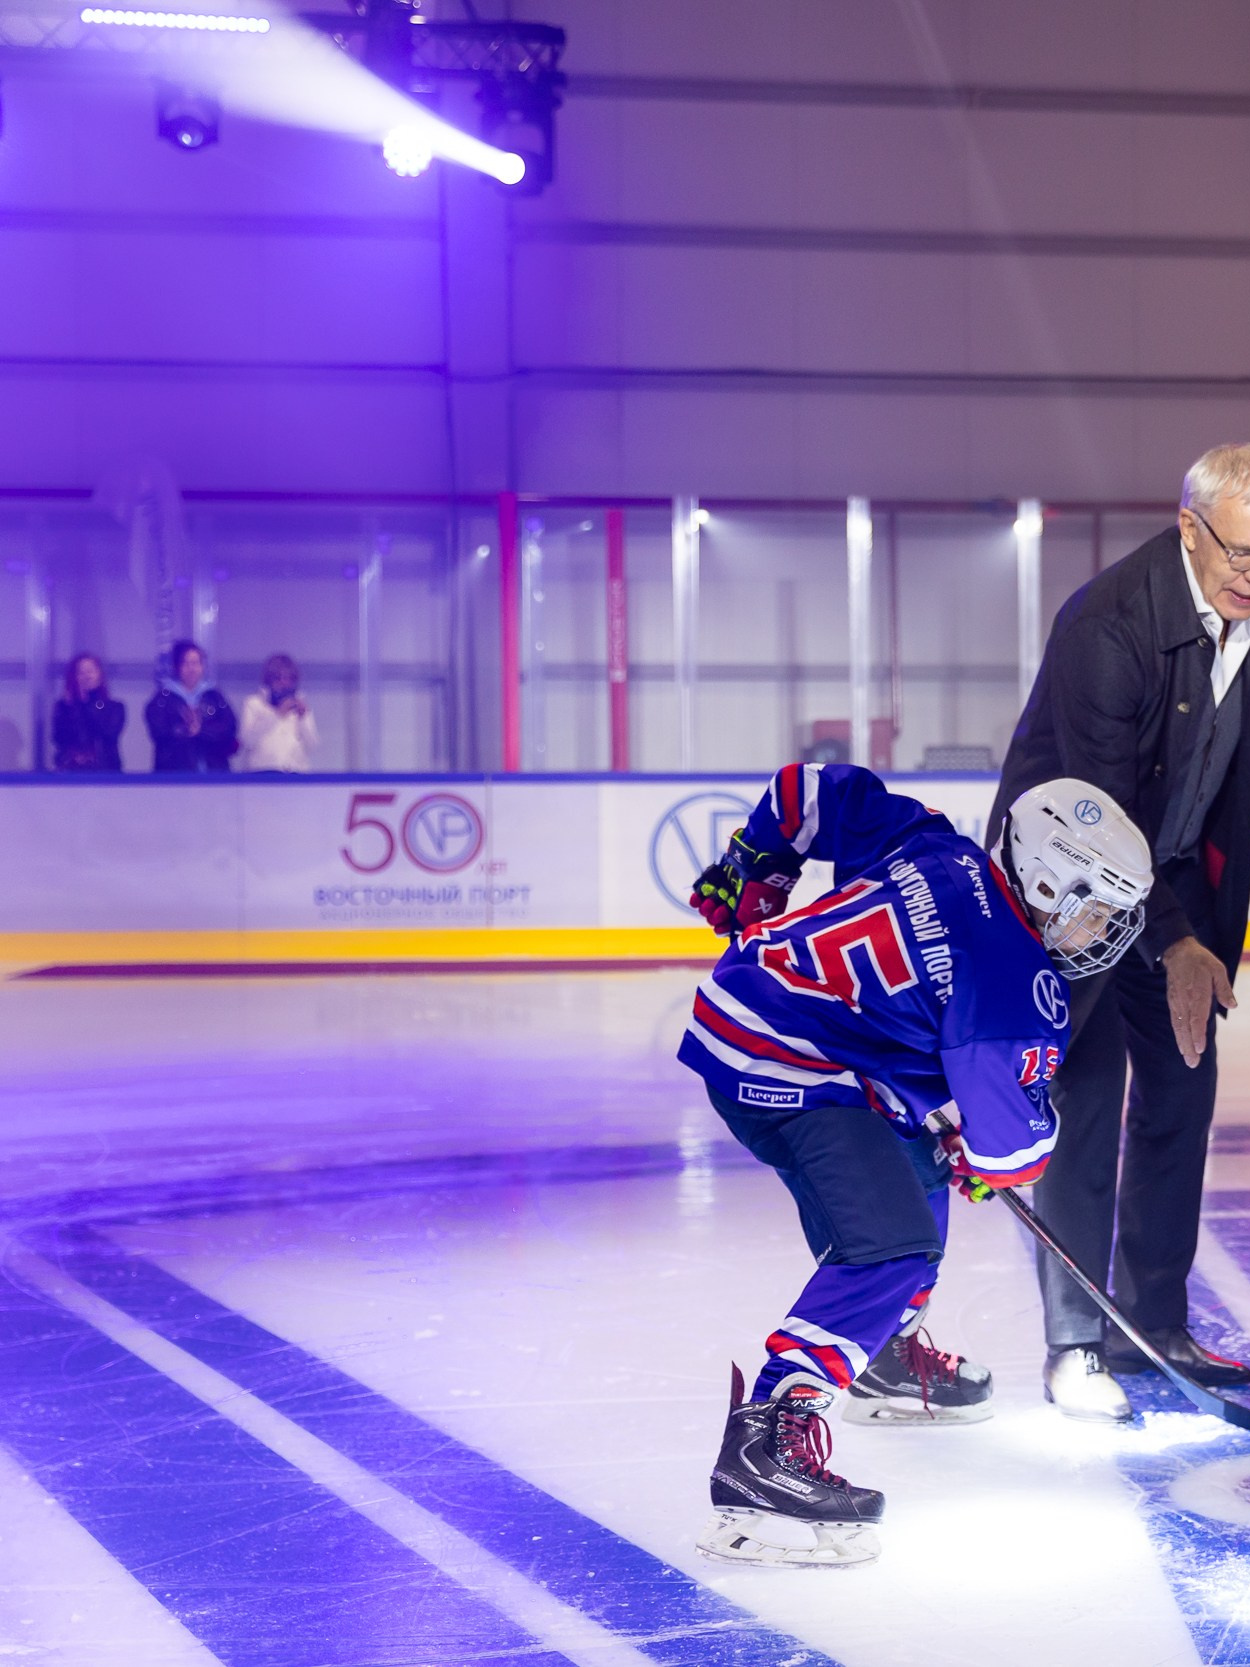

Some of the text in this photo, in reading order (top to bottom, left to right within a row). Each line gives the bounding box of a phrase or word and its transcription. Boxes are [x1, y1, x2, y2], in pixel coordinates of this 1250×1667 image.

[340, 792, 484, 875] 50
[1051, 840, 1092, 867] BAUER
[313, 884, 533, 907] ВОСТОЧНЫЙ ПОРТ
[967, 869, 992, 919] keeper
[747, 1088, 796, 1104] keeper
